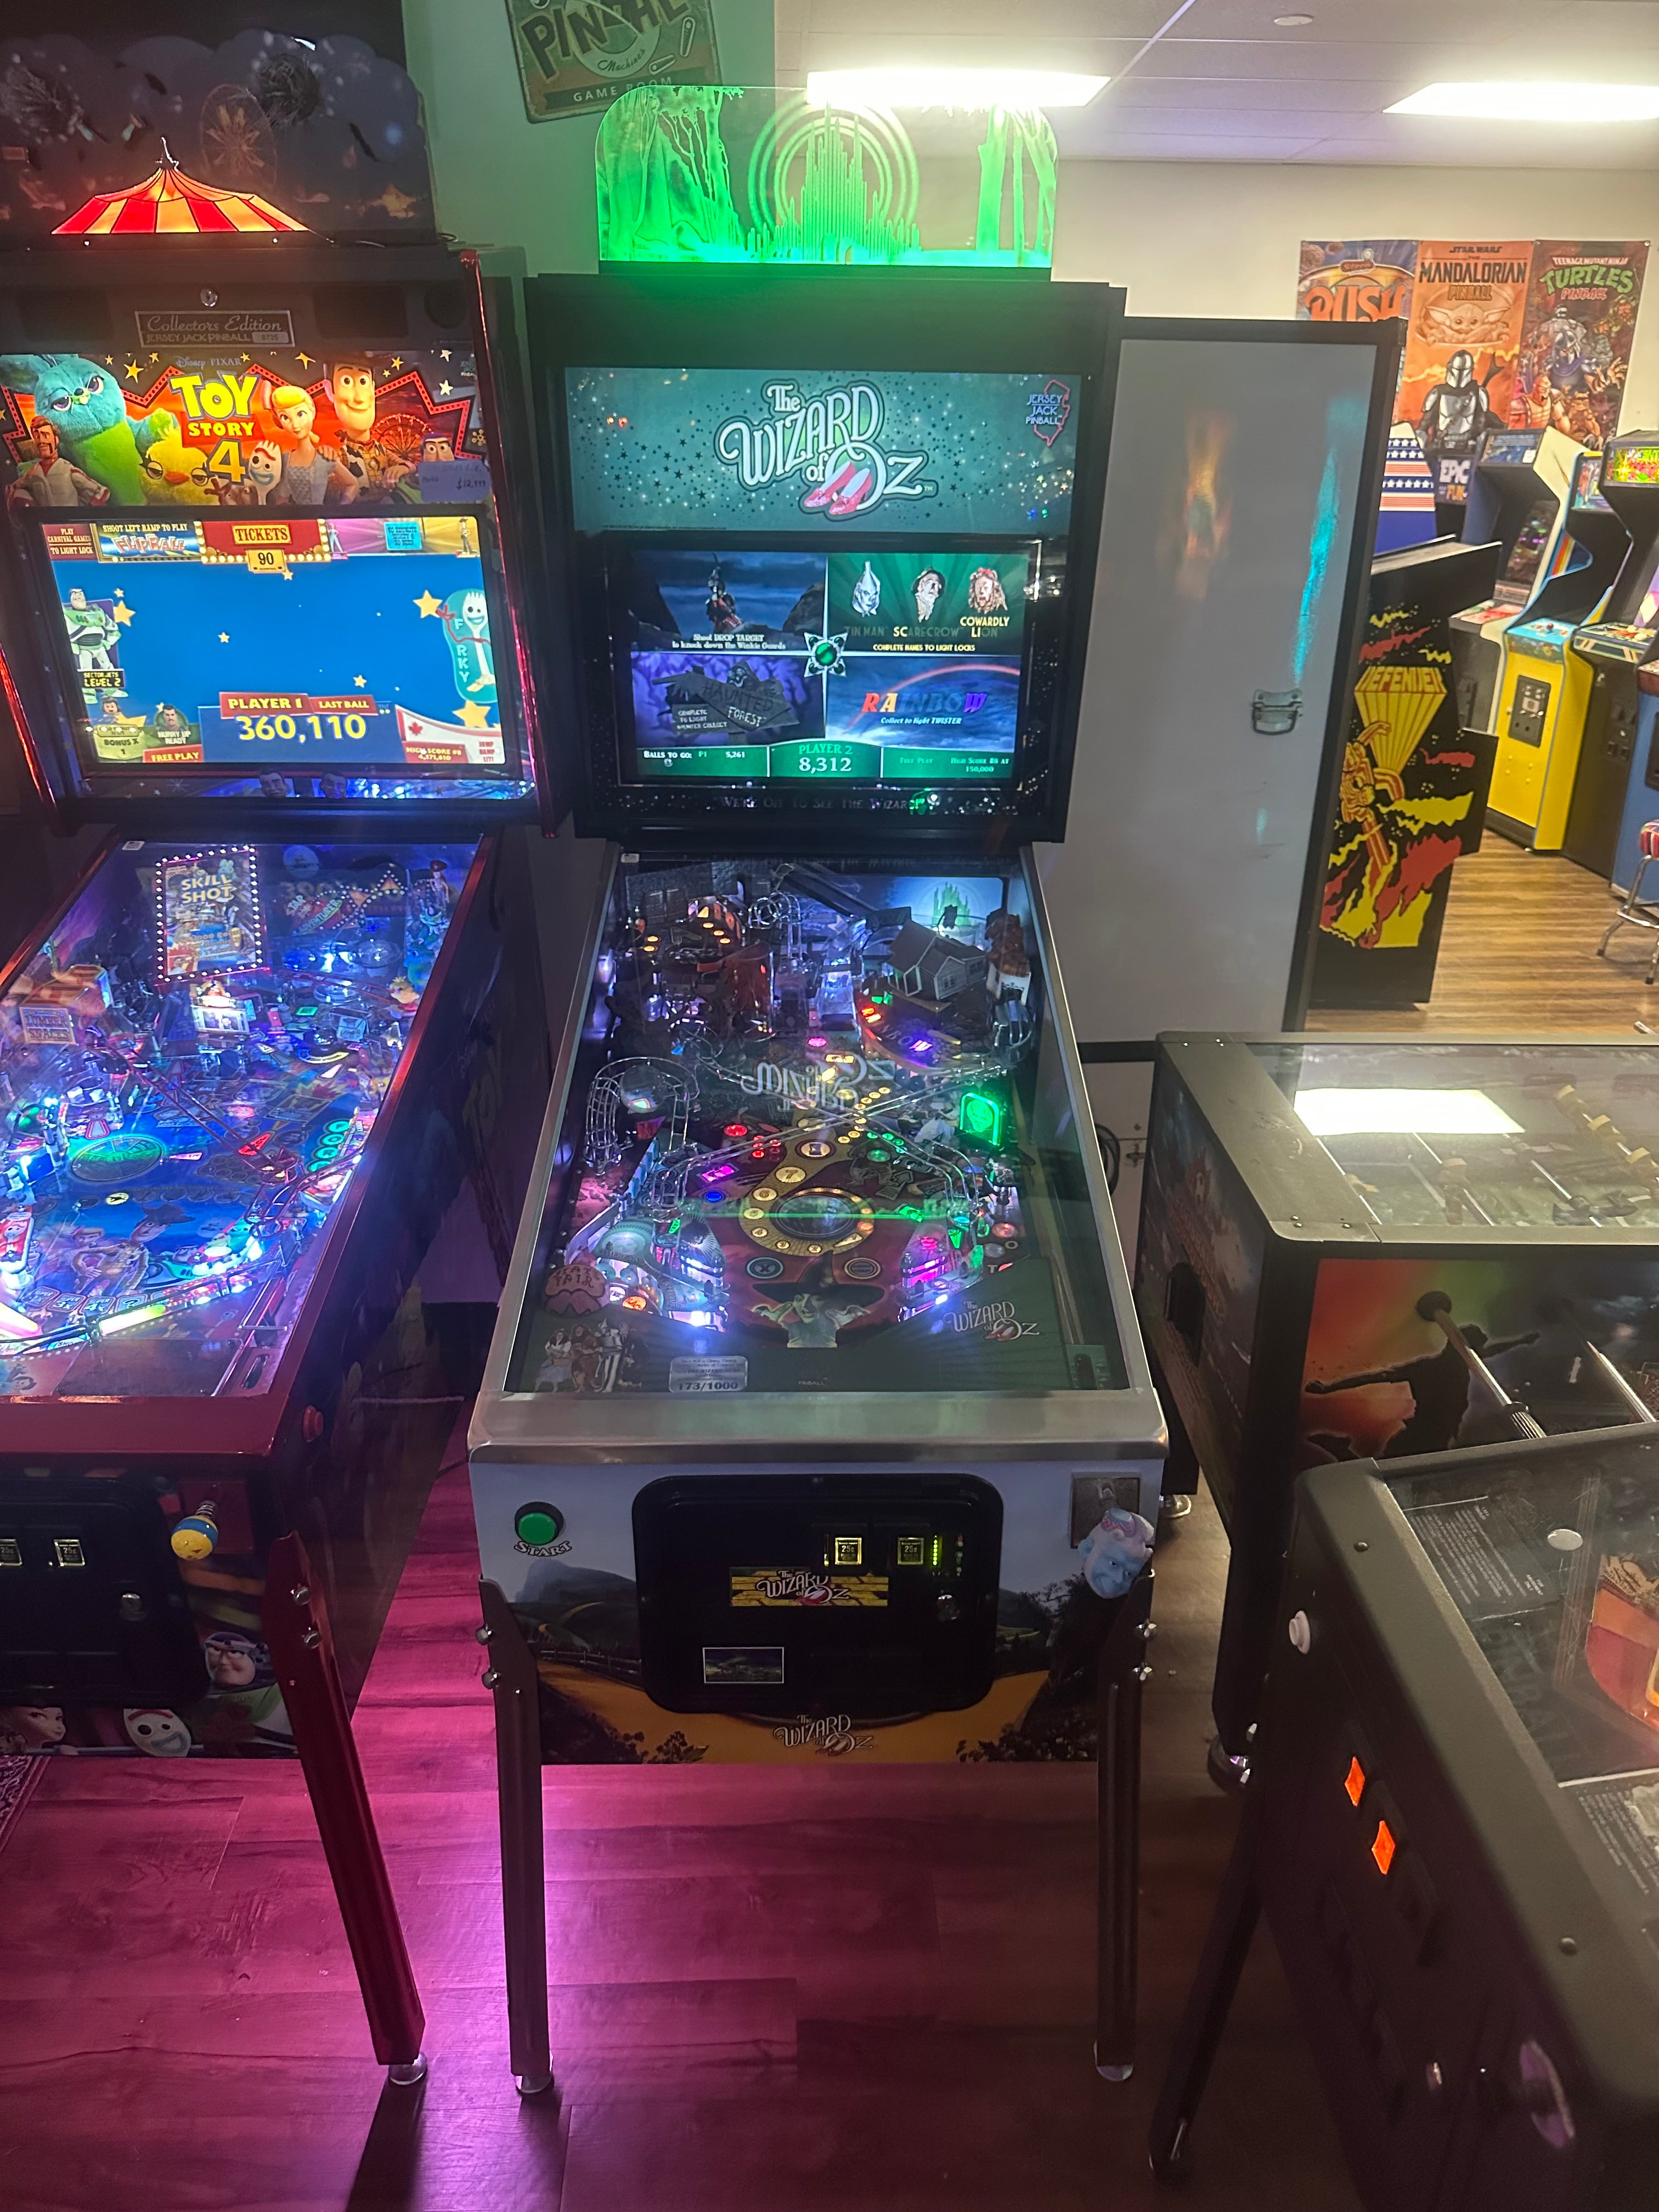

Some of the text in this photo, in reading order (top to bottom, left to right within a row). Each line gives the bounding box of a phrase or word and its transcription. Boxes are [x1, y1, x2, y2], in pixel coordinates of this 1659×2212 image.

[573, 86, 618, 101] GAME
[1553, 257, 1584, 265] TEENAGE
[1419, 262, 1527, 283] MANDALORIAN
[1539, 264, 1635, 294] TURTLES
[1447, 284, 1493, 300] PINBALL
[1560, 288, 1608, 300] PINBALL
[148, 315, 282, 331] Collectors Edition
[146, 334, 180, 343] JERSEY
[183, 334, 207, 343] JACK
[208, 332, 251, 343] PINBALL
[210, 357, 242, 366] PIXAR
[168, 372, 260, 420] TOY
[767, 384, 802, 413] The
[1026, 394, 1063, 405] JERSEY
[1030, 406, 1058, 417] JACK
[1025, 416, 1060, 425] PINBALL
[188, 422, 255, 437] STORY
[719, 386, 879, 486] WIZARD
[208, 440, 247, 483] 4
[806, 441, 924, 511] of Oz
[1439, 459, 1471, 484] EPIC
[235, 527, 288, 541] TICKETS
[112, 533, 185, 554] FLIPBALL
[258, 552, 274, 566] 90
[959, 616, 1010, 627] COWARDLY
[713, 634, 735, 642] DROP
[845, 626, 998, 638] TIN MAN SCARECROW LION
[454, 618, 470, 683] FRKY
[680, 641, 702, 649] knock
[84, 678, 121, 687] LEVEL 2
[1355, 665, 1447, 693] DEFENDER
[228, 698, 292, 709] PLAYER
[703, 682, 774, 712] HAUNTED
[861, 692, 988, 713] RAINBOW
[318, 701, 342, 709] LAST
[727, 706, 763, 727] FOREST
[913, 717, 930, 725] light
[235, 714, 366, 744] 360,110
[151, 752, 199, 761] FREE PLAY
[427, 747, 451, 755] SCORE
[798, 744, 853, 755] PLAYER 2
[798, 757, 853, 774] 8,312
[181, 874, 232, 890] SKILL
[182, 885, 231, 904] SHOT
[785, 1169, 798, 1180] 7
[988, 1265, 998, 1273] T
[963, 1301, 979, 1309] The
[943, 1301, 1015, 1332] WIZARD
[992, 1318, 1040, 1340] Oz
[679, 1382, 738, 1392] 173/1000
[514, 1541, 572, 1556] START
[778, 1570, 794, 1578] The
[772, 1714, 851, 1747] WIZARD
